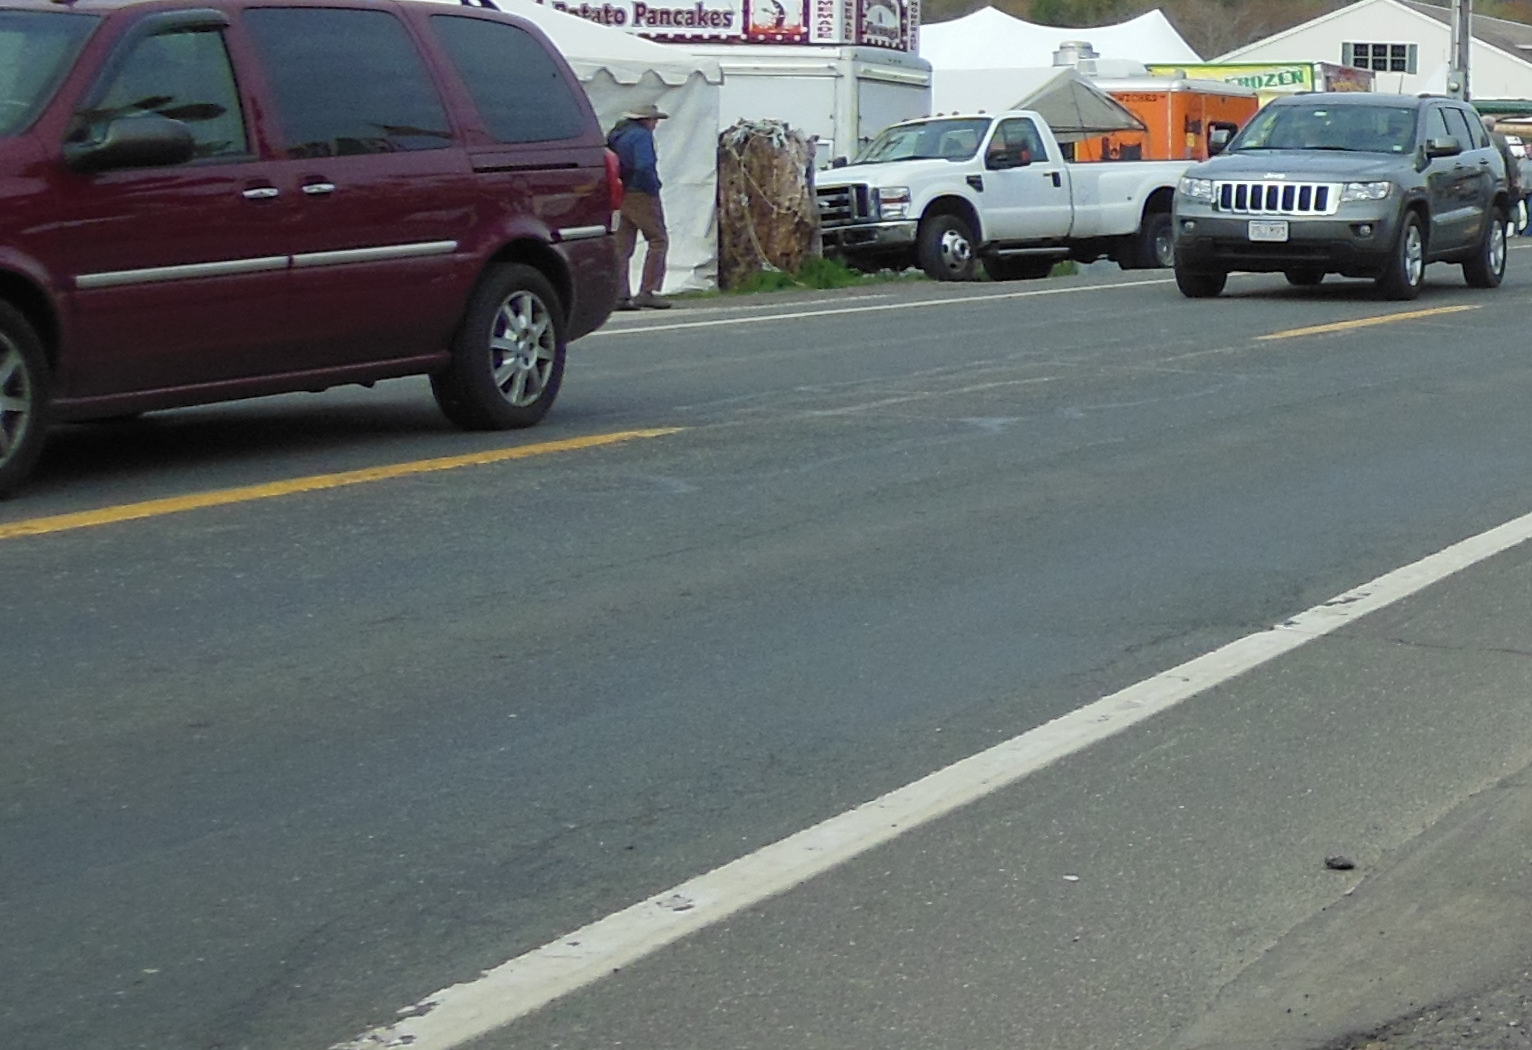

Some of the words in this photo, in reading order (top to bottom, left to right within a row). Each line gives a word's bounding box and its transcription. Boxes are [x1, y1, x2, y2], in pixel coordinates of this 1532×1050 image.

[553, 2, 628, 27] tato
[632, 1, 735, 28] Pancakes
[1224, 69, 1304, 89] ROZEN
